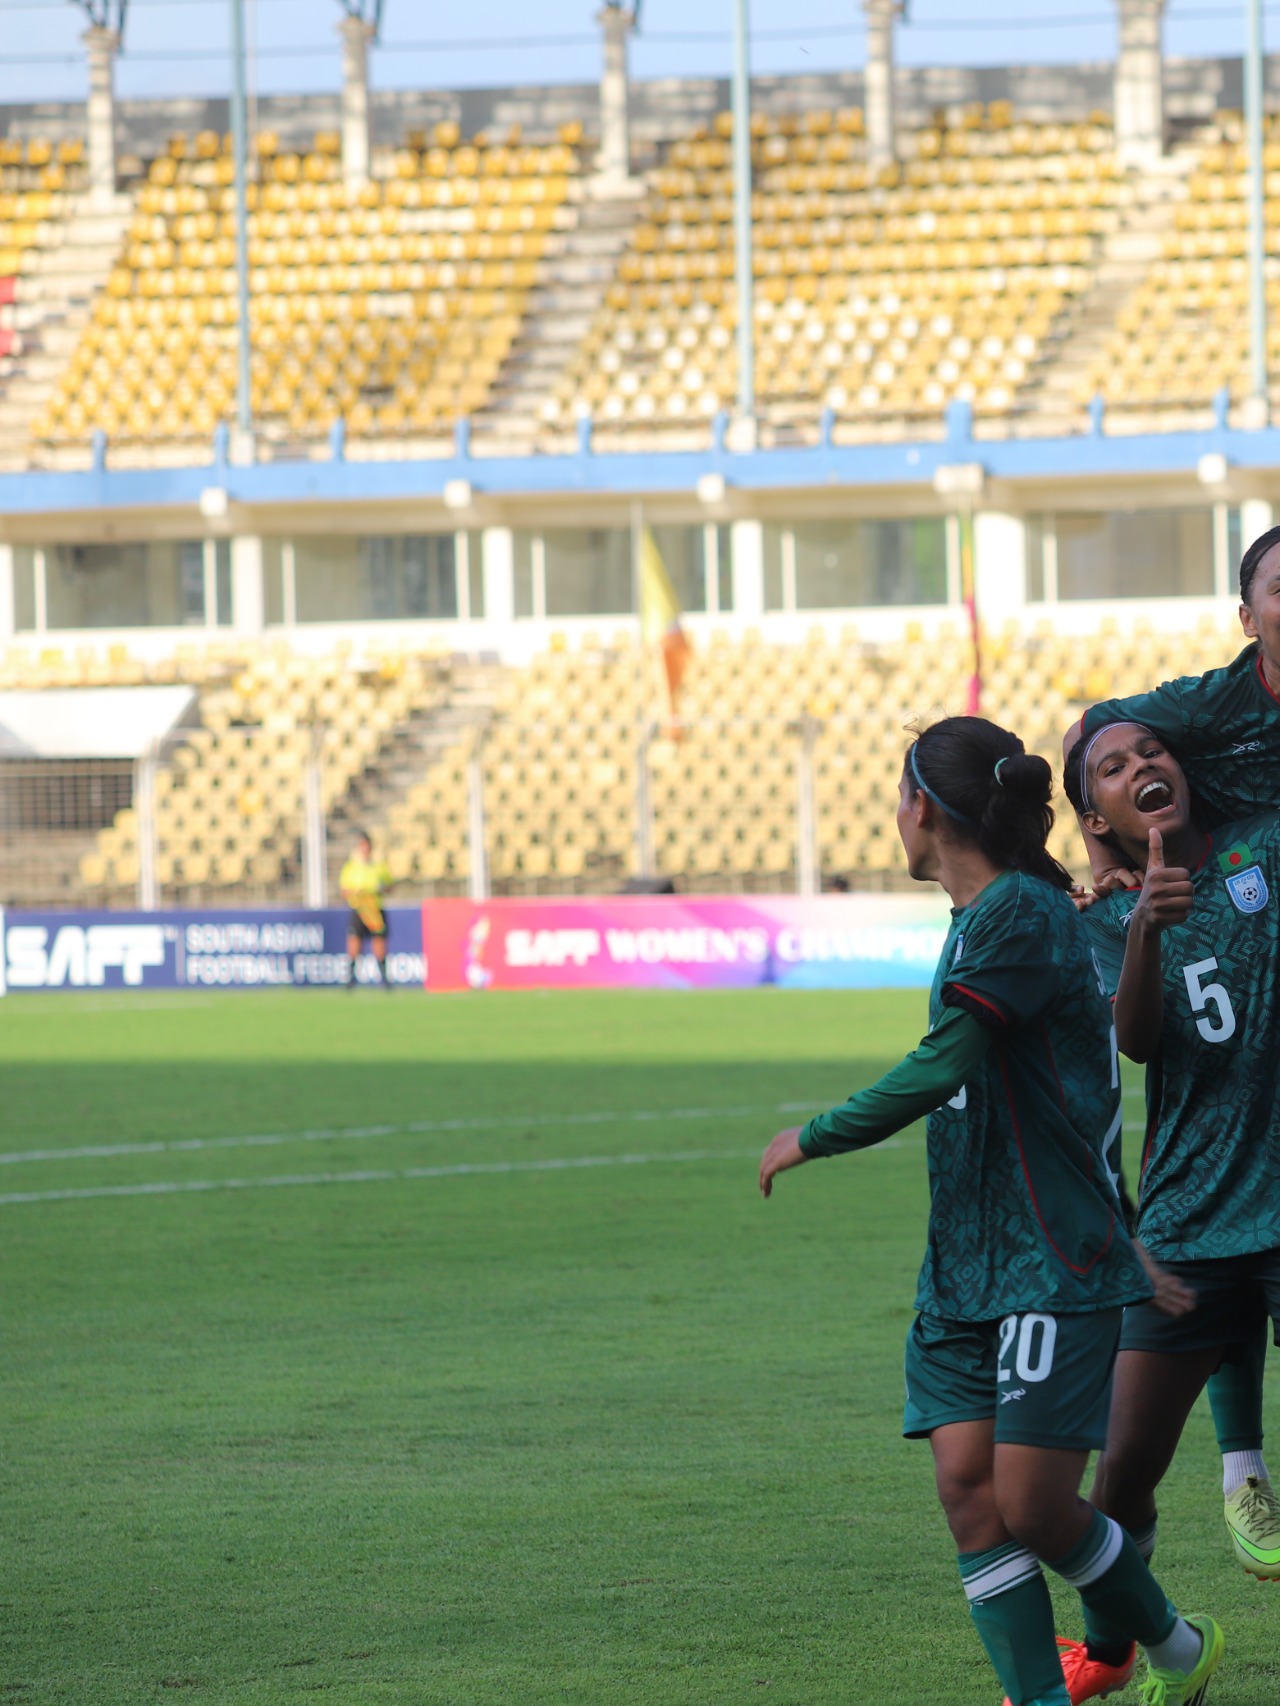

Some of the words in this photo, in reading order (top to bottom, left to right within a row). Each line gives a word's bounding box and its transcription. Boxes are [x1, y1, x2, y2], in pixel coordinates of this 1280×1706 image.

[7, 925, 165, 986] SAFF
[186, 923, 259, 953] SOUTH
[260, 923, 324, 952] ASIAN
[505, 929, 599, 966] SAFF
[605, 927, 768, 963] WOMEN'S
[187, 954, 292, 984] FOOTBALL
[1183, 956, 1236, 1043] 5
[997, 1314, 1057, 1382] 20
